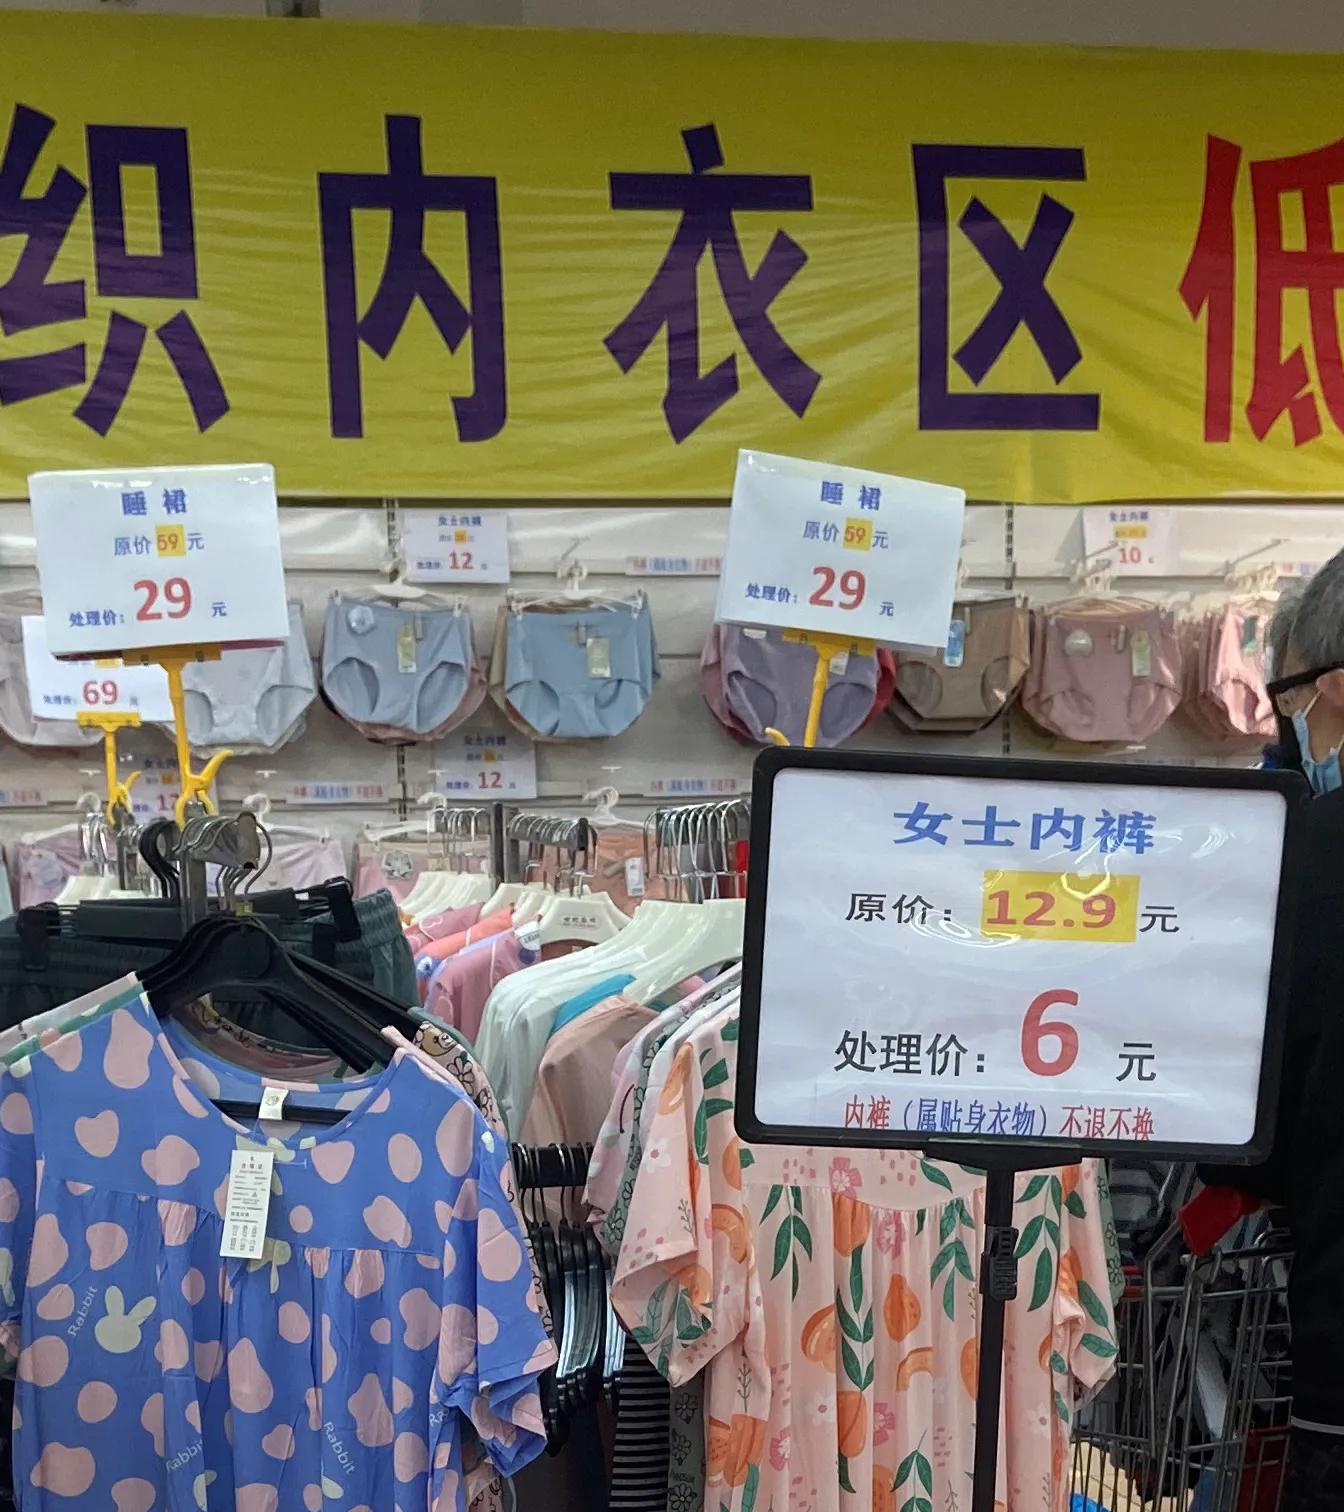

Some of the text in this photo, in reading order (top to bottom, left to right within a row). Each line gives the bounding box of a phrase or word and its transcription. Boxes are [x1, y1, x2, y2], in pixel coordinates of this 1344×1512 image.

[121, 489, 188, 517] 睡裙
[821, 480, 882, 512] 睡裙
[448, 551, 474, 570] 12
[133, 576, 192, 623] 29
[808, 564, 867, 612] 29
[83, 680, 119, 705] 69
[477, 771, 504, 790] 12
[893, 801, 1158, 855] 女士内裤
[985, 889, 1118, 930] 12.9
[1139, 905, 1180, 934] 元
[1019, 988, 1080, 1078] 6
[1116, 1041, 1158, 1083] 元
[67, 1284, 98, 1337] Rabbit
[323, 1420, 356, 1476] Rabbit
